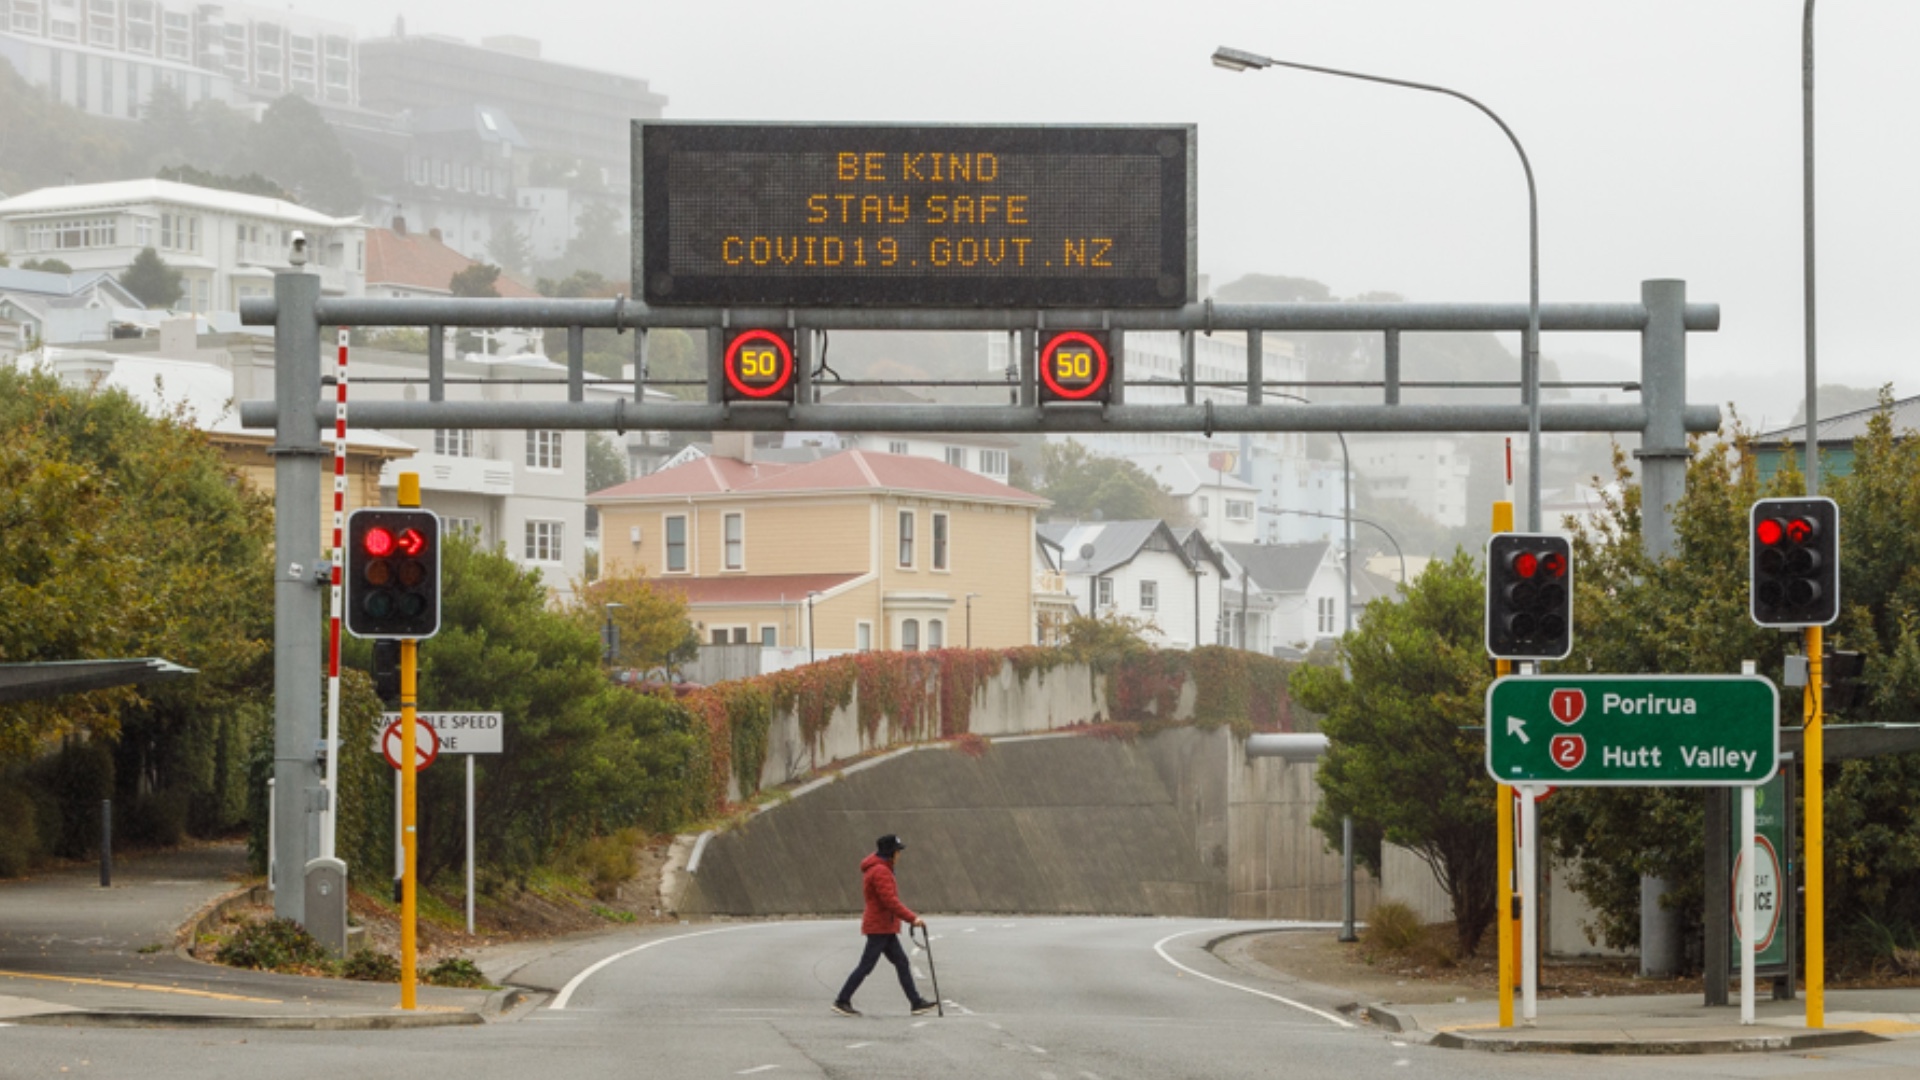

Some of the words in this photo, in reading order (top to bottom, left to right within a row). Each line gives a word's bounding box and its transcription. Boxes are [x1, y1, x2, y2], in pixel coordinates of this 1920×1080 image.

[837, 152, 886, 181] BE
[902, 152, 998, 182] KIND
[806, 194, 910, 224] STAY
[926, 195, 1029, 224] SAFE
[741, 348, 776, 377] 50
[1057, 350, 1091, 379] 50
[1564, 696, 1571, 717] 1
[1603, 693, 1697, 715] Porirua
[451, 715, 497, 729] SPEED
[1561, 740, 1575, 761] 2
[1603, 746, 1662, 767] Hutt
[1680, 746, 1757, 772] Valley
